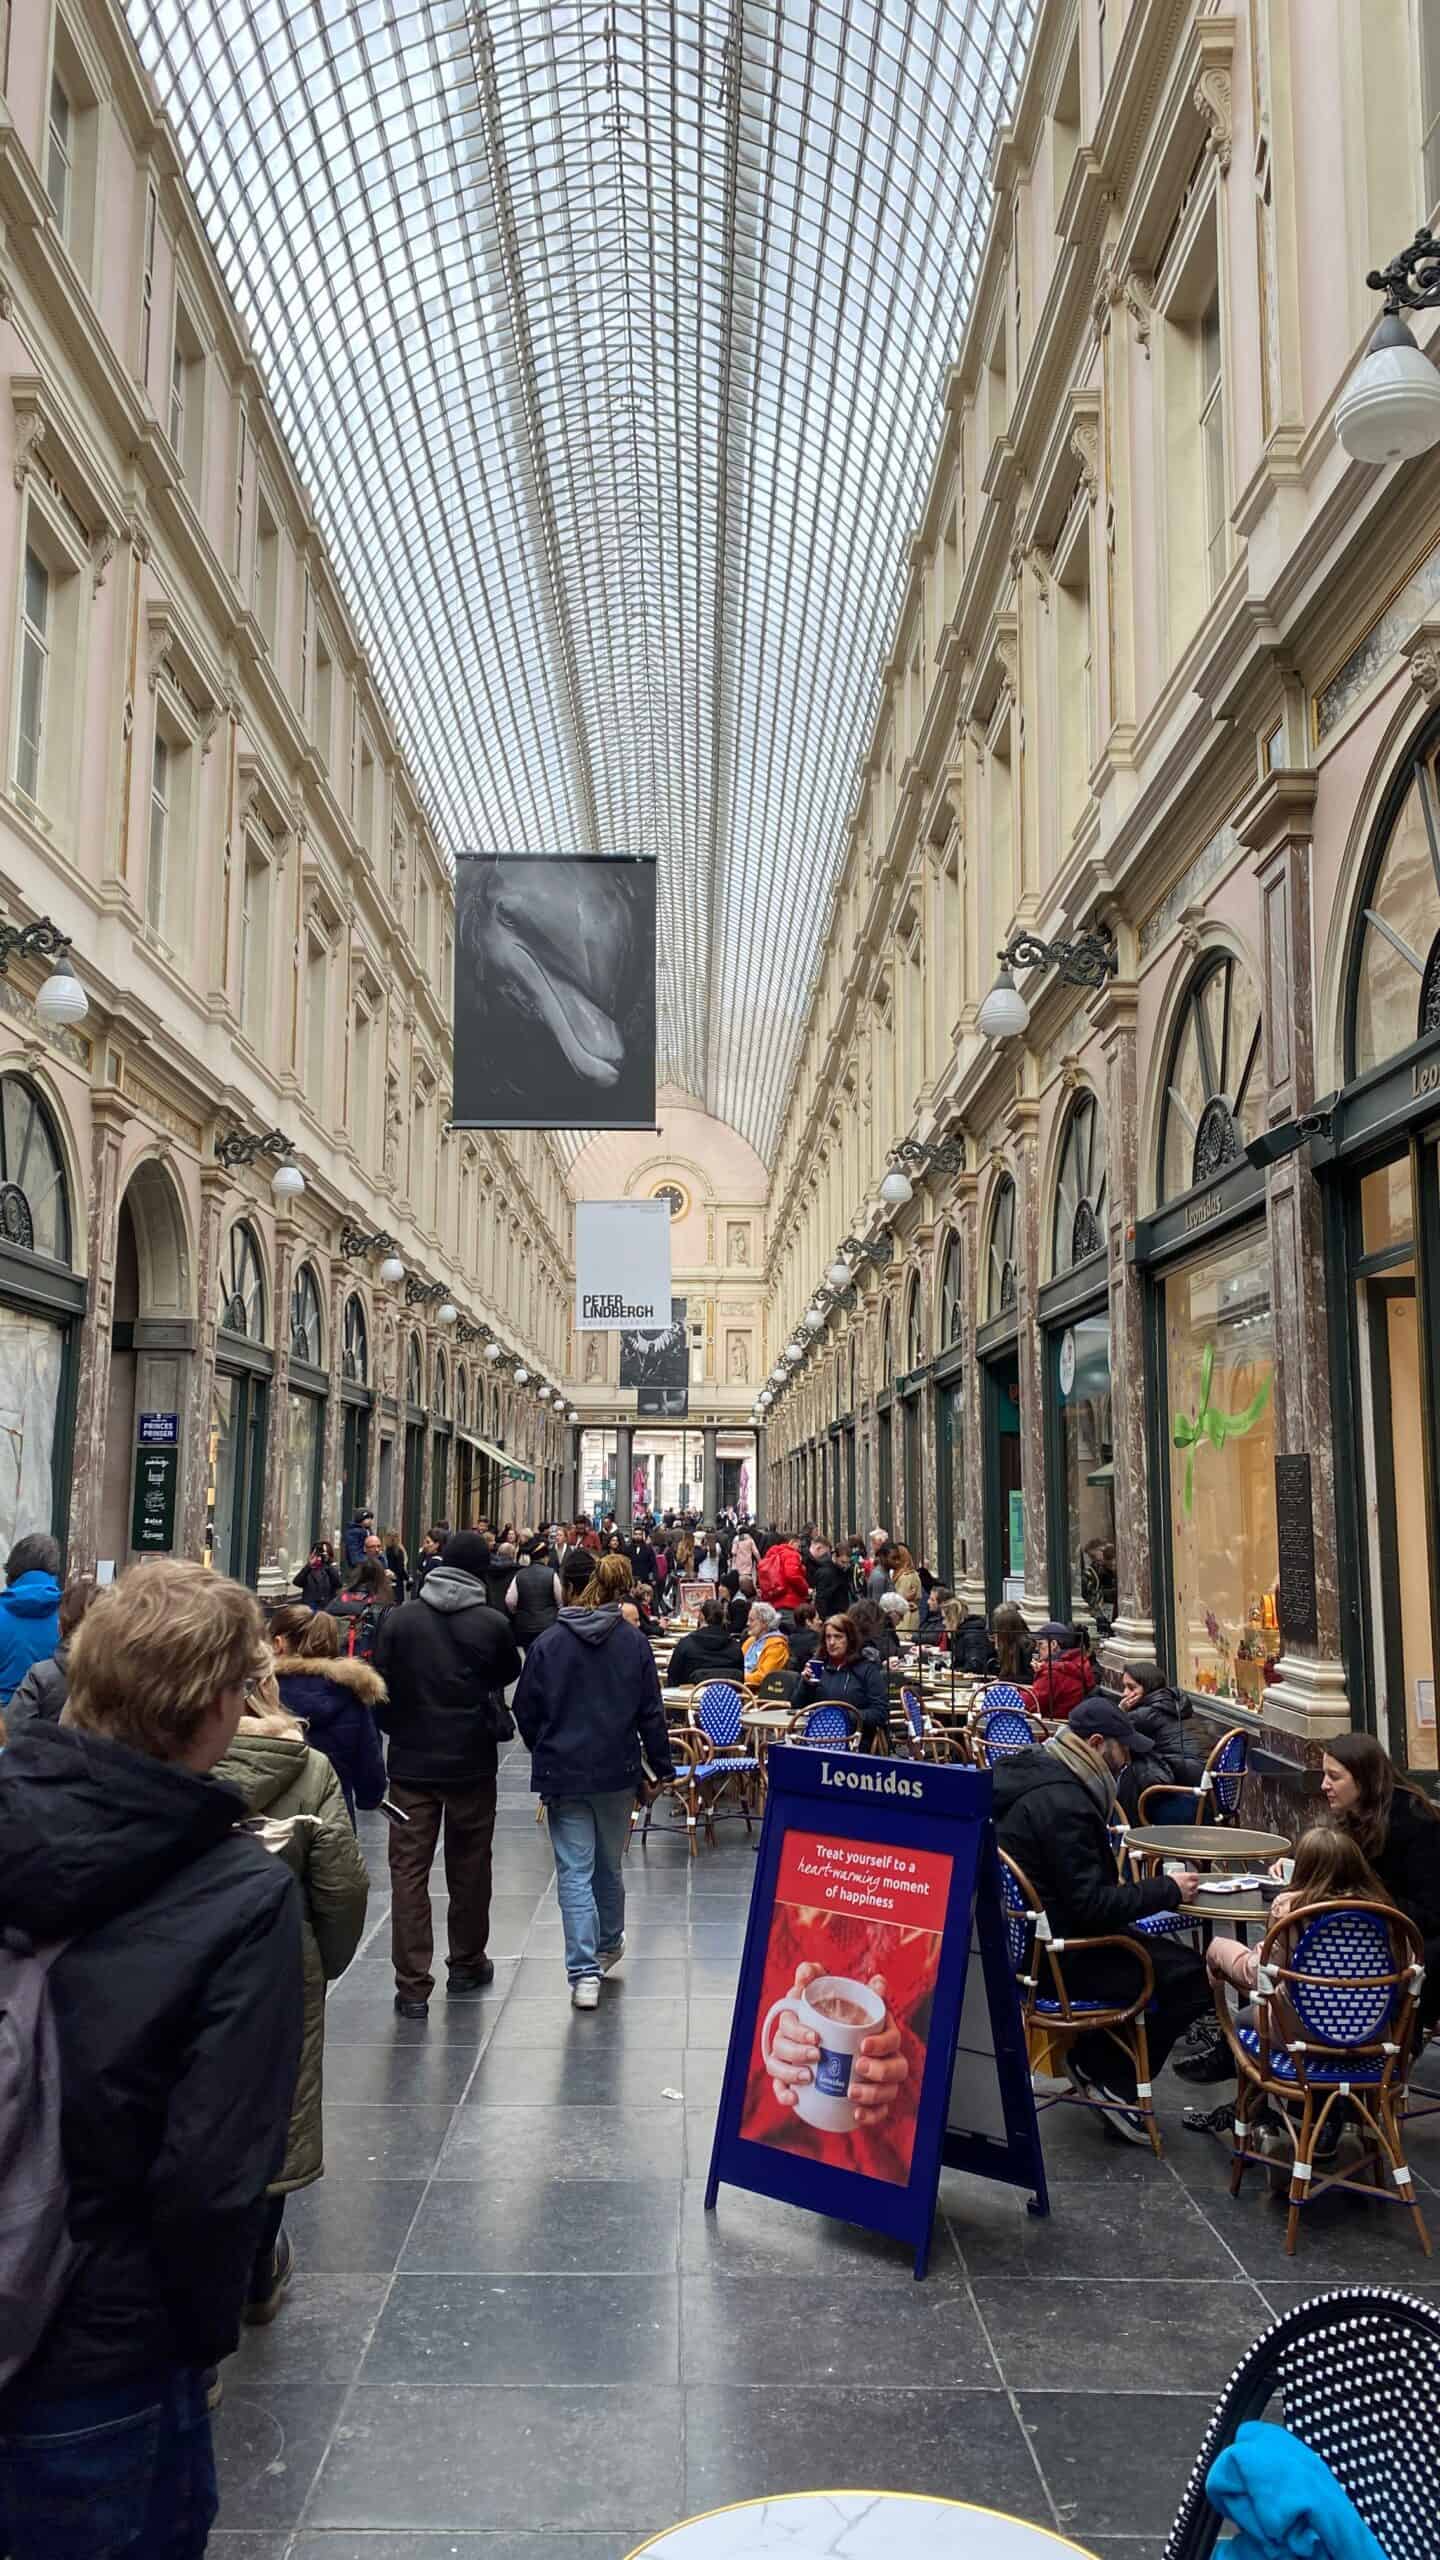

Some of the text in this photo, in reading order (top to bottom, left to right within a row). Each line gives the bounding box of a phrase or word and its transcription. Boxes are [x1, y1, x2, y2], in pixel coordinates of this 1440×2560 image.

[1411, 1064, 1440, 1098] Leo
[1184, 1193, 1221, 1229] Leonidas
[583, 1295, 623, 1307] PETER
[583, 1304, 654, 1318] LINDBERGH
[821, 1761, 923, 1798] Leonidas
[816, 1845, 916, 1873] Treat yourself to a
[797, 1856, 930, 1895] heart-warming moment
[825, 1885, 894, 1909] of happiness
